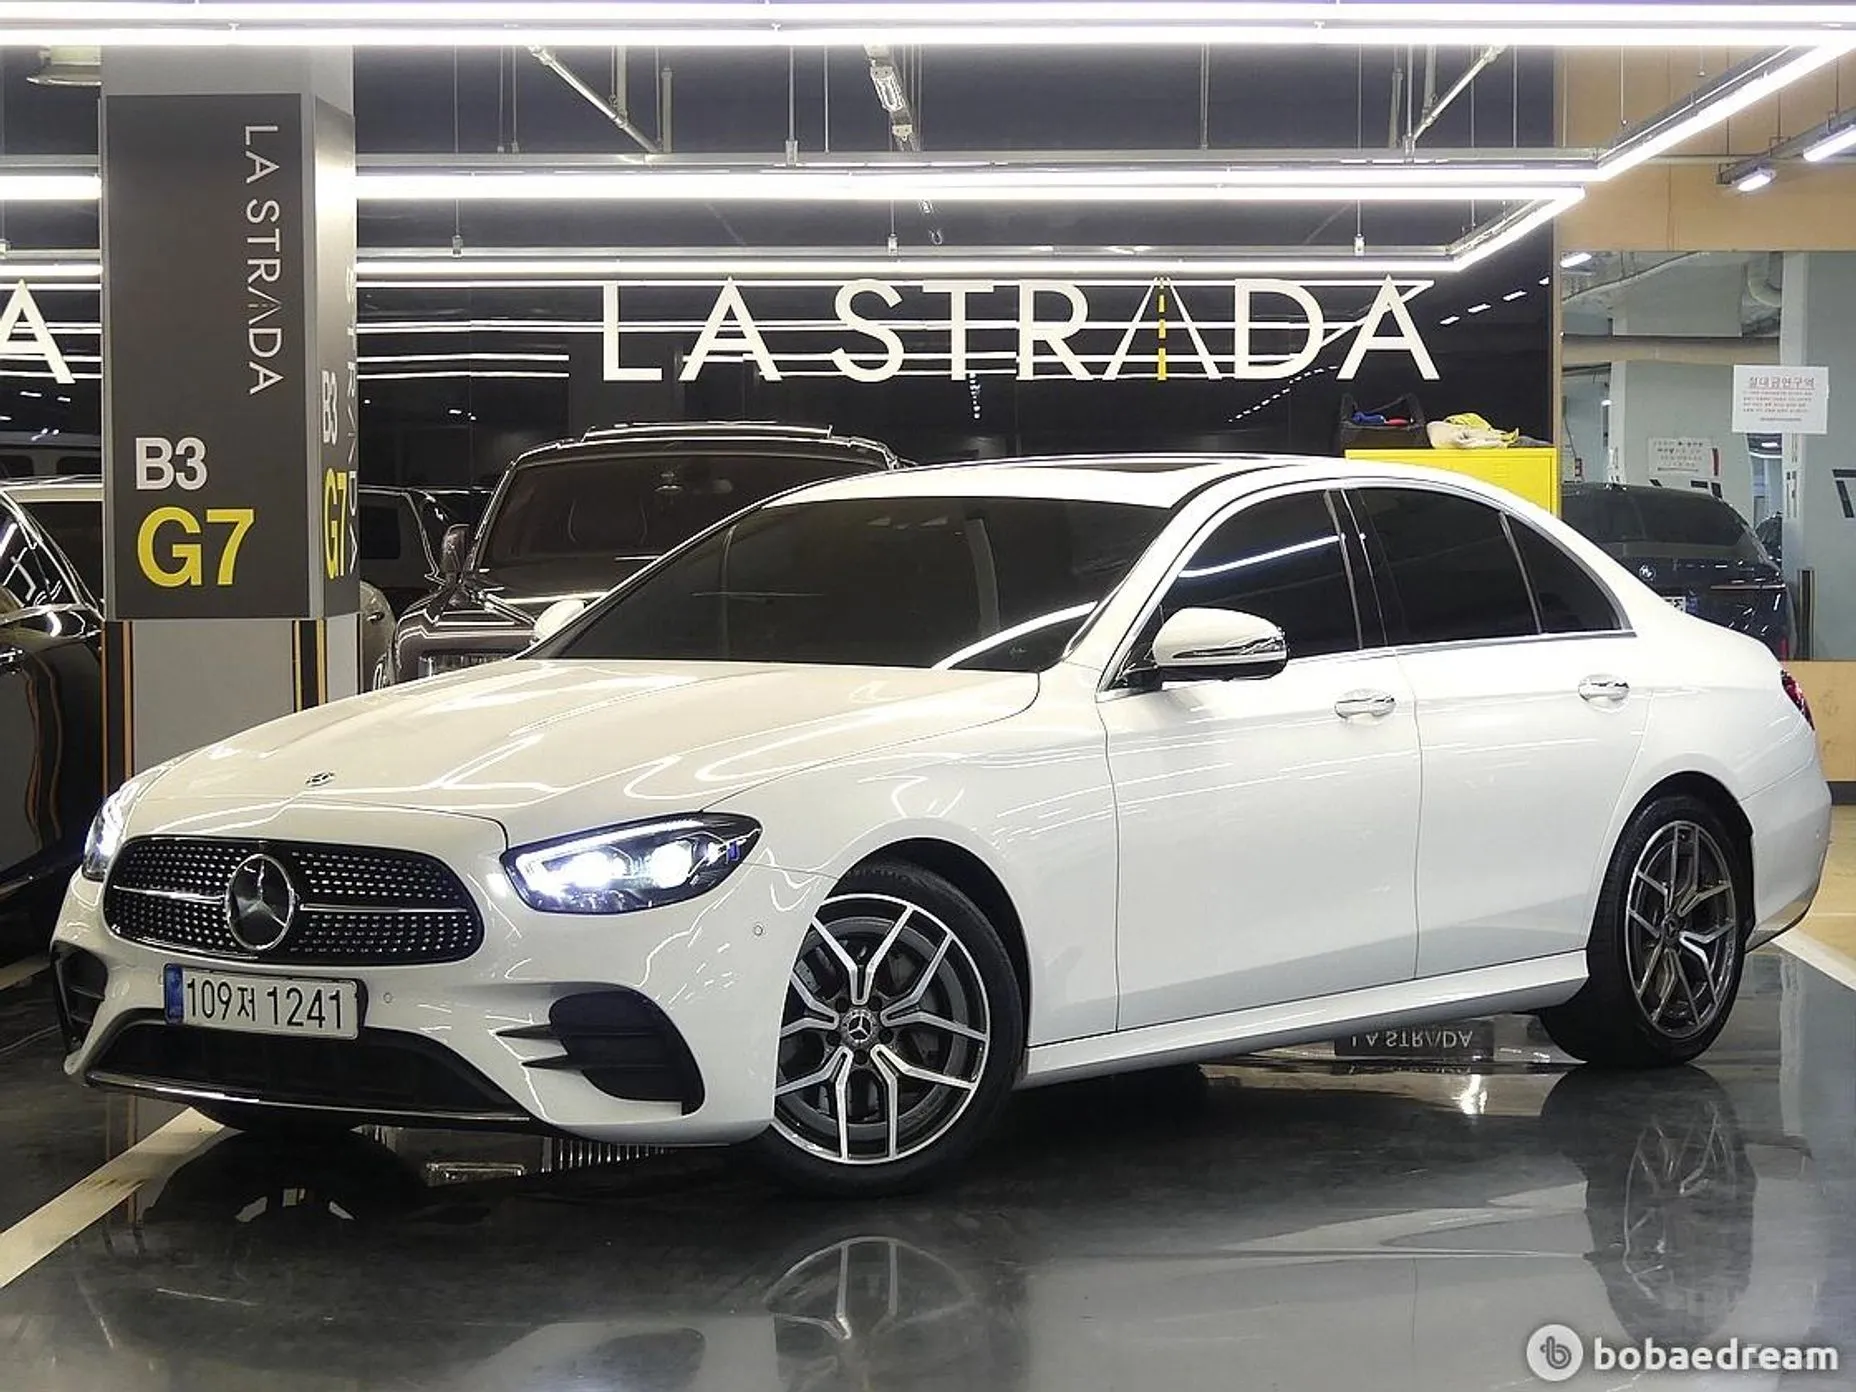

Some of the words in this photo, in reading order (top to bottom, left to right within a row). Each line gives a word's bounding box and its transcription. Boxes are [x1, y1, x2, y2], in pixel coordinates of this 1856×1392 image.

[245, 126, 280, 183] LA
[246, 199, 284, 395] STRADA
[603, 275, 782, 382] LA
[831, 275, 1440, 383] STRADA
[321, 369, 338, 446] B3
[135, 436, 208, 491] B3
[137, 506, 255, 588] G7
[324, 467, 347, 580] G7
[187, 977, 256, 1022] 109저
[266, 985, 342, 1030] 1241
